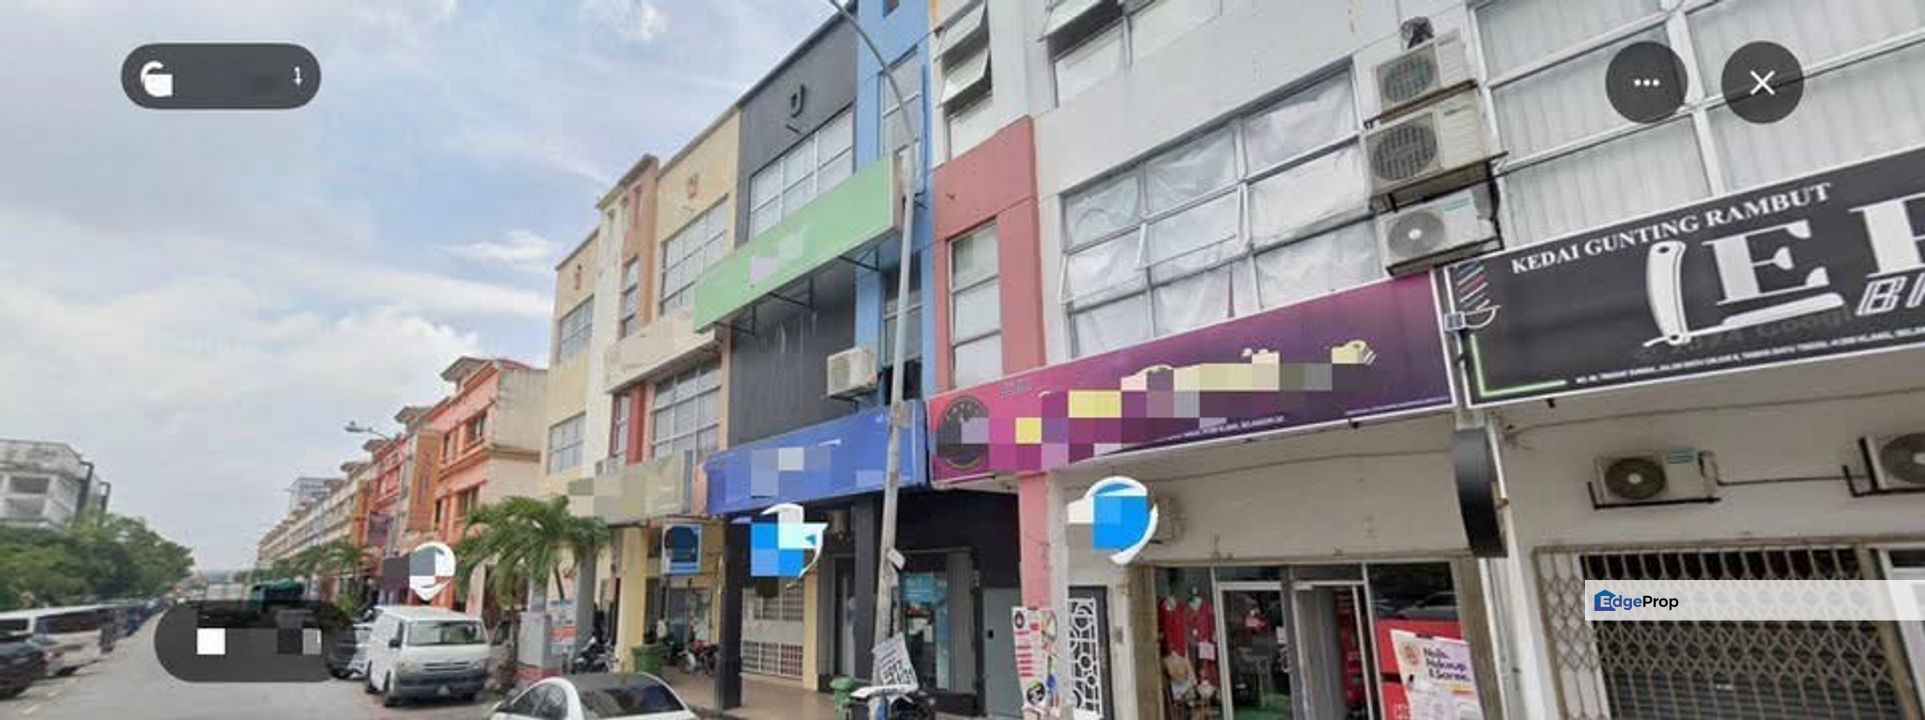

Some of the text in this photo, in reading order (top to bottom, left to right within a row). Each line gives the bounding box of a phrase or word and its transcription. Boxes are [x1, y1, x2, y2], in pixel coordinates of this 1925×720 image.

[1511, 181, 1832, 275] KEDAI GUNTING RAMBUT
